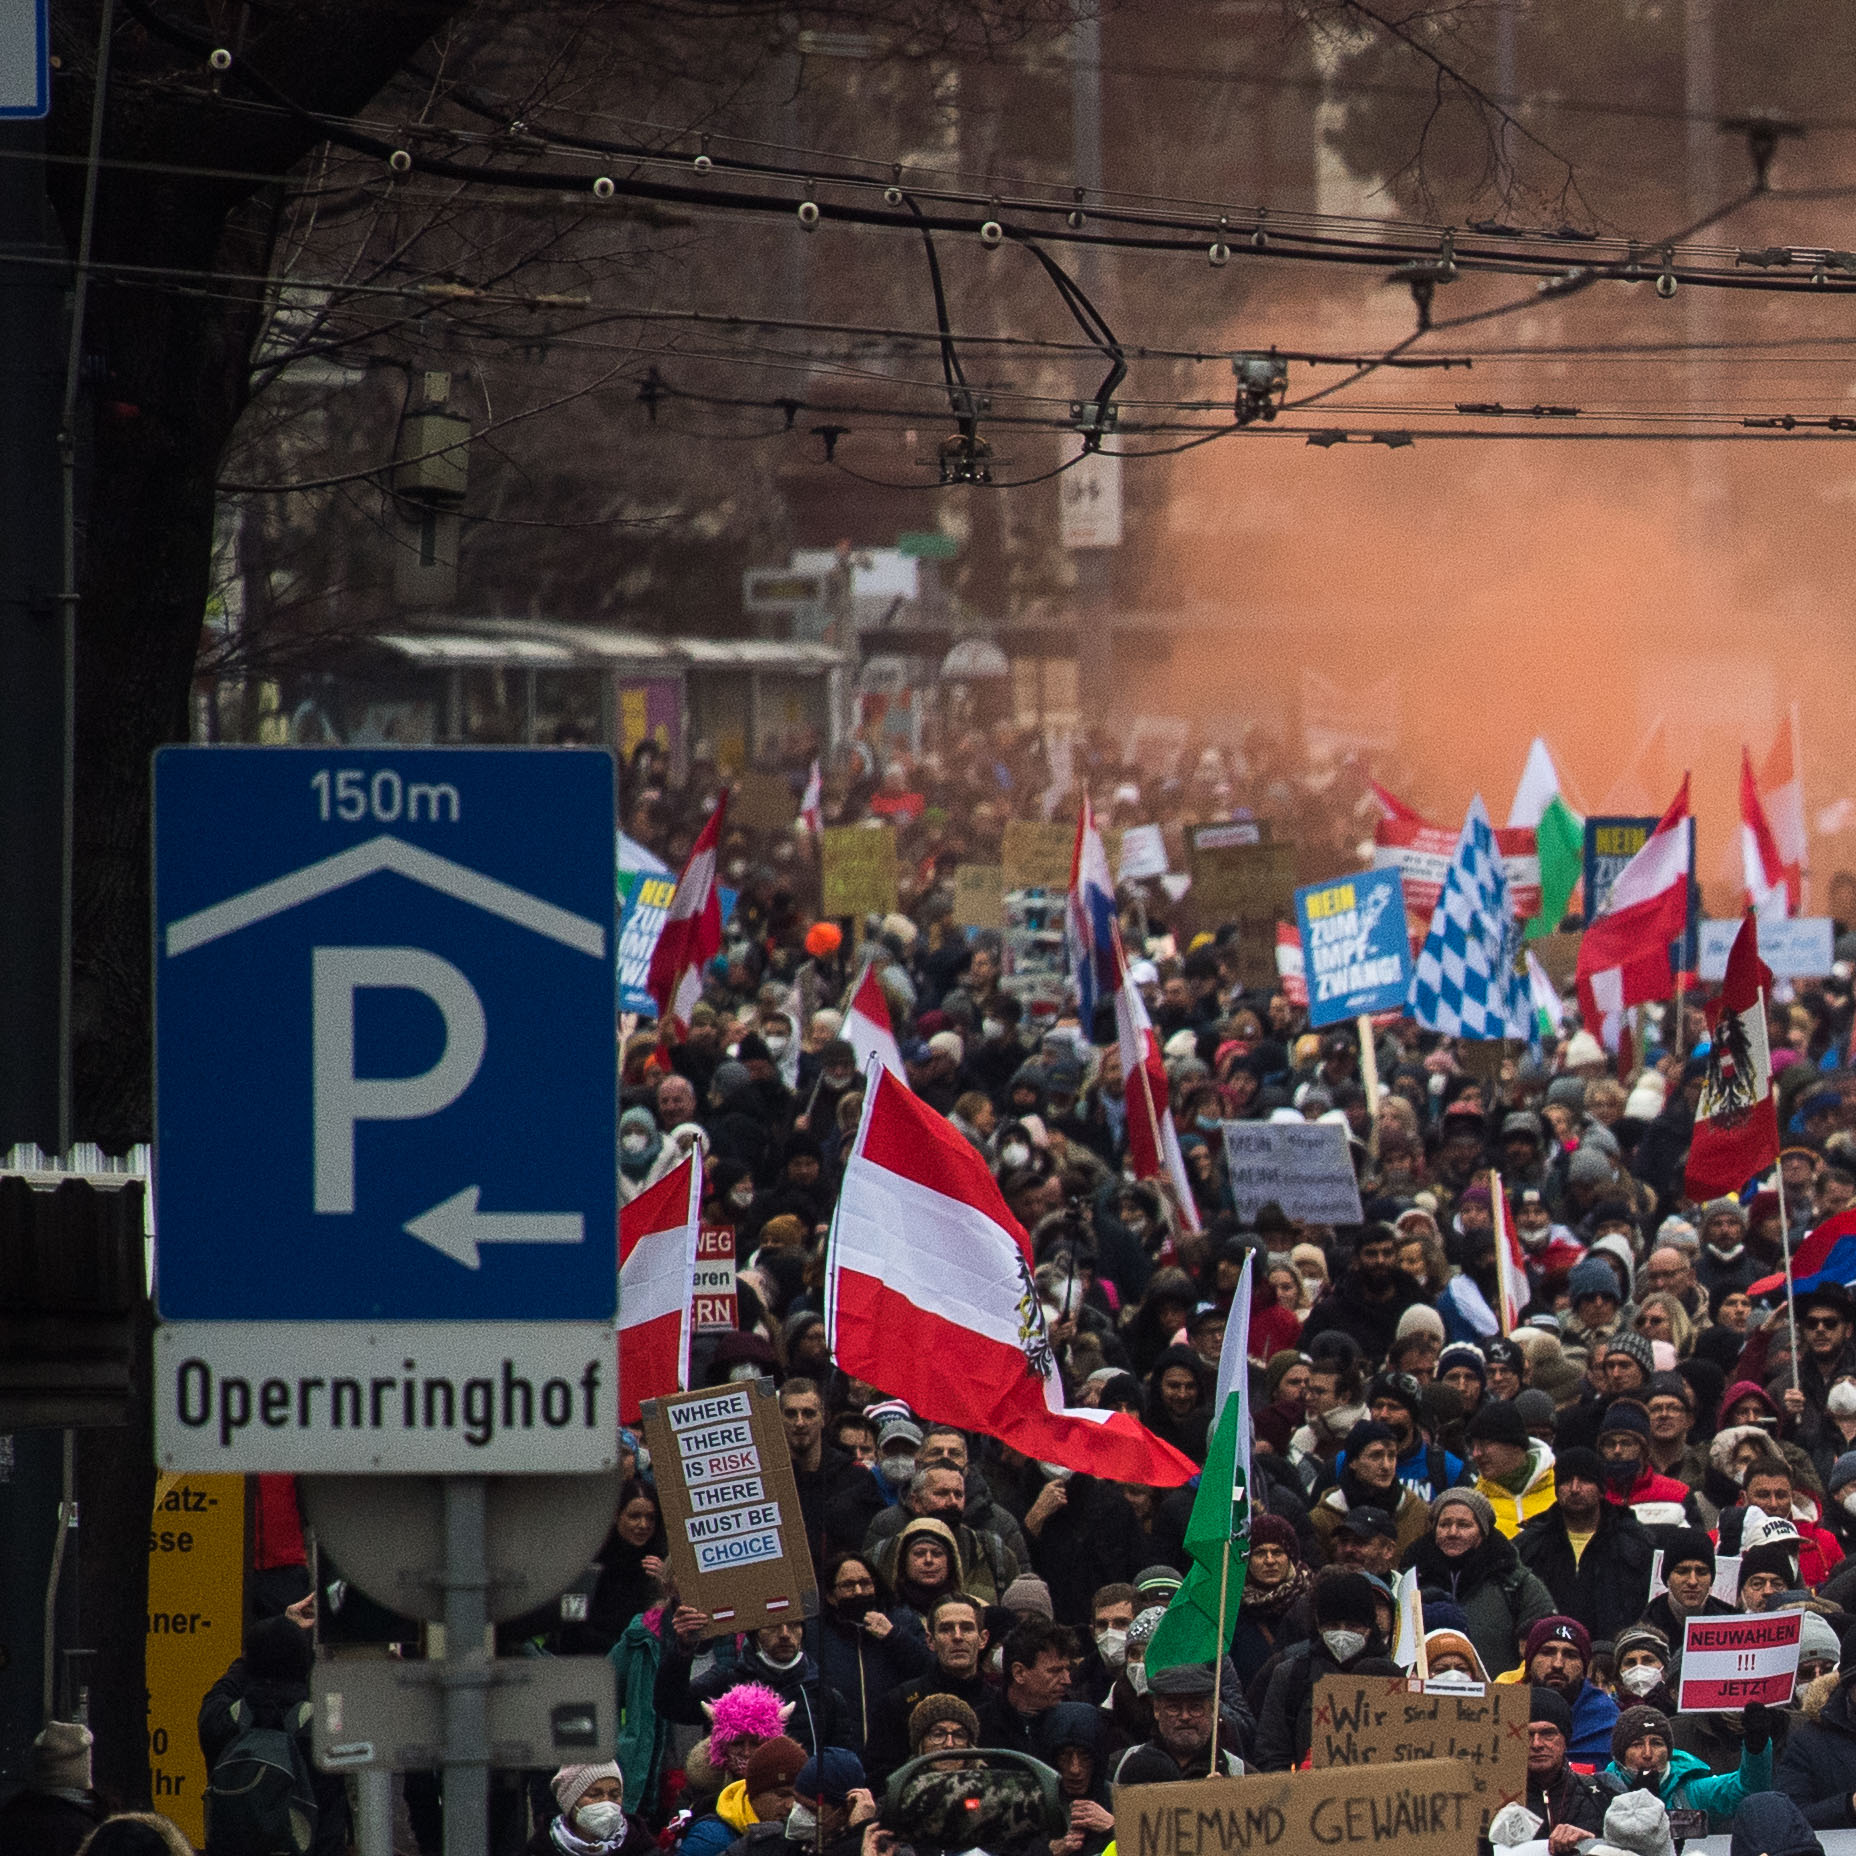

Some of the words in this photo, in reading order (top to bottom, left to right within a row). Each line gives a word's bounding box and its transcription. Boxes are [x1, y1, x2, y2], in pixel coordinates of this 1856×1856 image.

[310, 769, 460, 823] 150m
[1306, 883, 1356, 919] NEIN
[1311, 911, 1359, 945] ZUM
[1312, 937, 1379, 968] IMPF-
[1316, 956, 1401, 1001] ZWANG!
[313, 946, 488, 1214] P
[176, 1357, 602, 1448] Opernringhof
[671, 1396, 745, 1426] WHERE
[681, 1426, 748, 1454] THERE
[685, 1462, 705, 1480] IS
[708, 1451, 756, 1477] RISK
[695, 1481, 760, 1508] THERE
[690, 1513, 743, 1539] MUST
[749, 1507, 776, 1526] BE
[702, 1535, 777, 1564] CHOICE
[1690, 1623, 1796, 1647] NEUWAHLEN
[1737, 1653, 1756, 1671] !!!
[1717, 1679, 1769, 1697] JETZT
[1328, 1690, 1387, 1733] Wir
[1403, 1699, 1440, 1725] sind
[1326, 1733, 1378, 1766] Wir
[1310, 1789, 1472, 1845] GEWÄHRT
